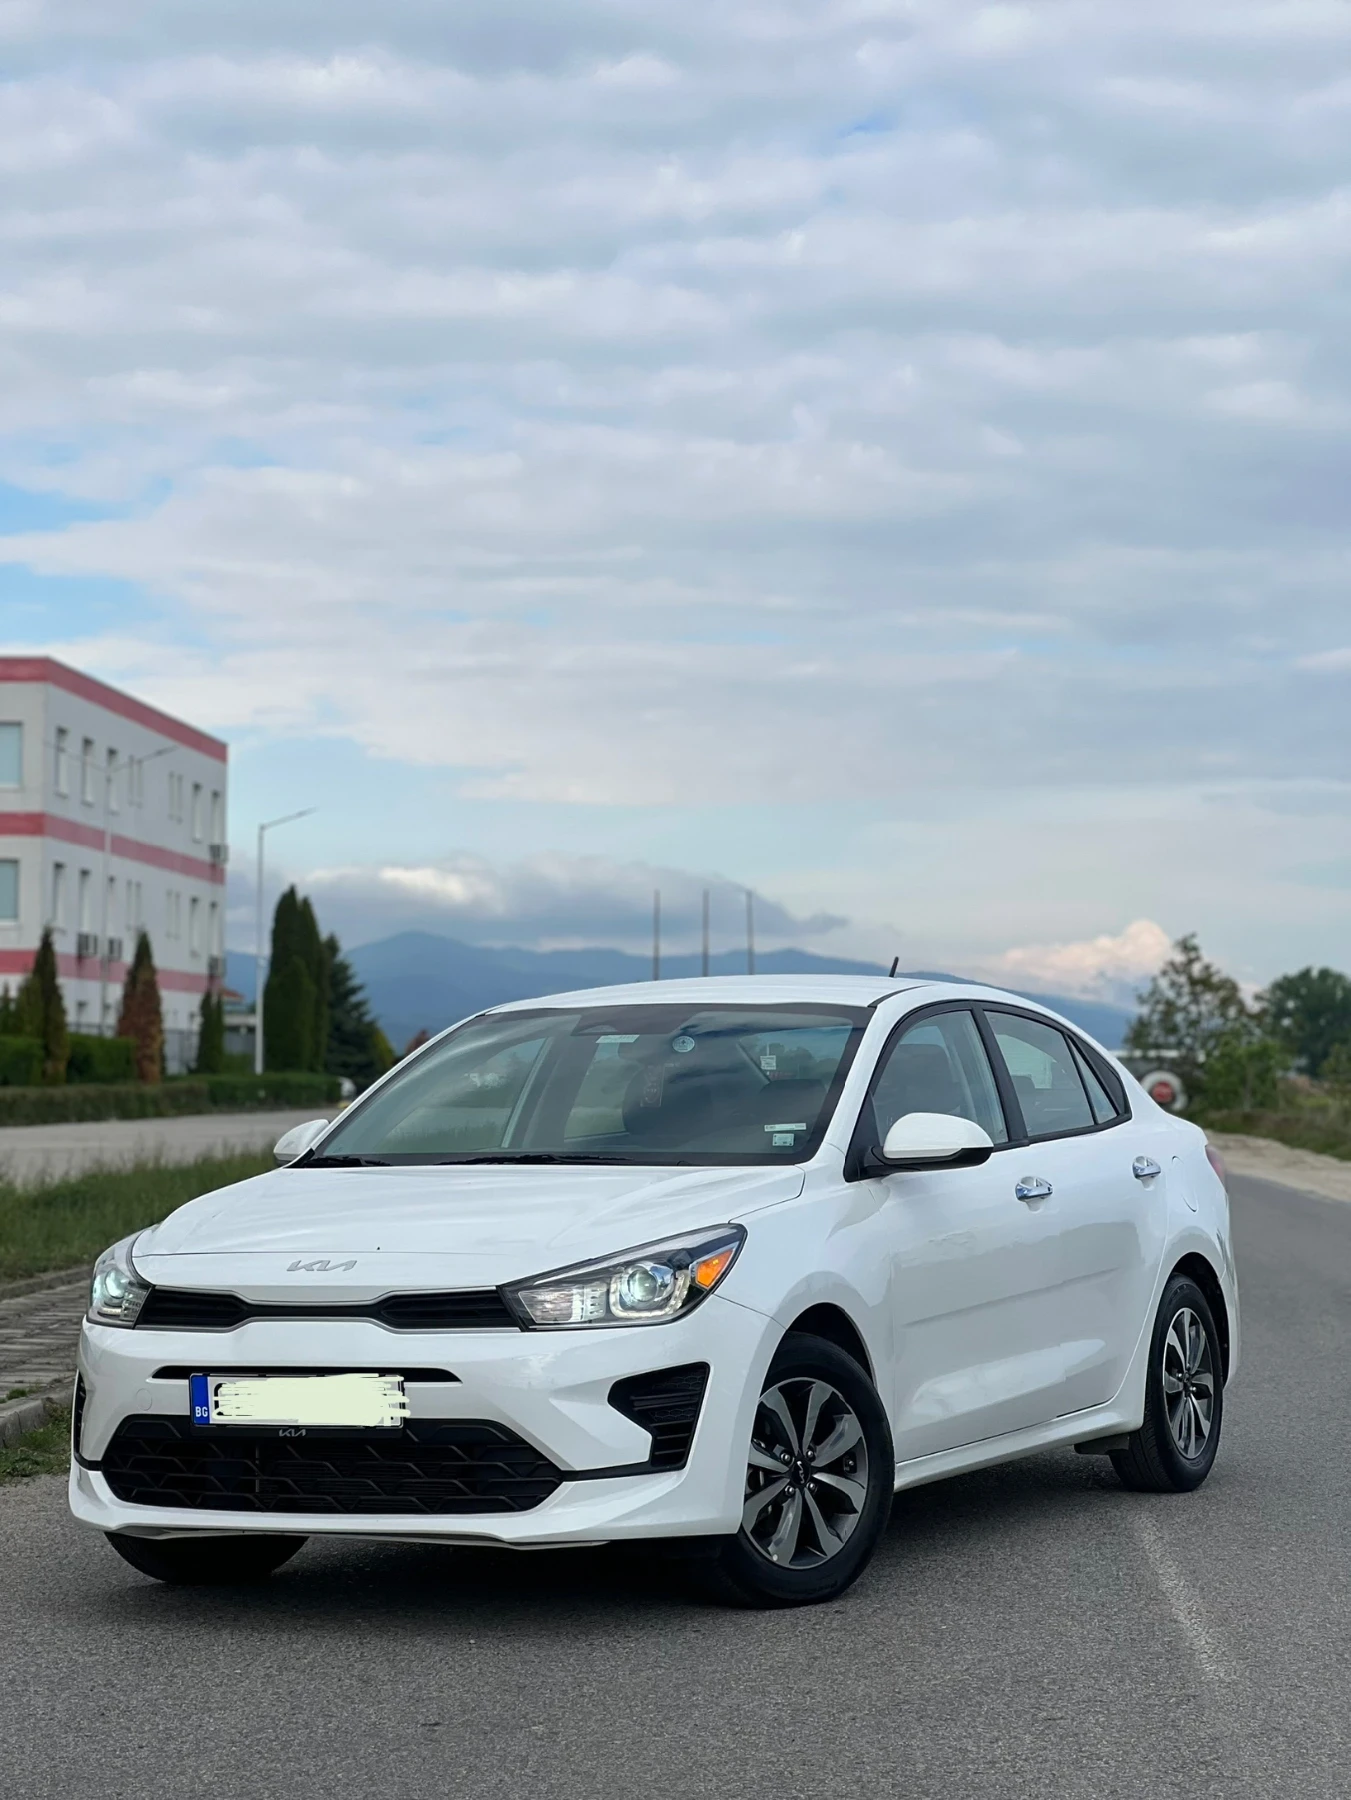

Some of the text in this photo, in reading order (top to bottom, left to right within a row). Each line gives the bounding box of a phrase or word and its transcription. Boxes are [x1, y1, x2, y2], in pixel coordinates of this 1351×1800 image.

[286, 1259, 358, 1272] KIA
[195, 1406, 208, 1418] BG
[278, 1428, 306, 1437] KIA
